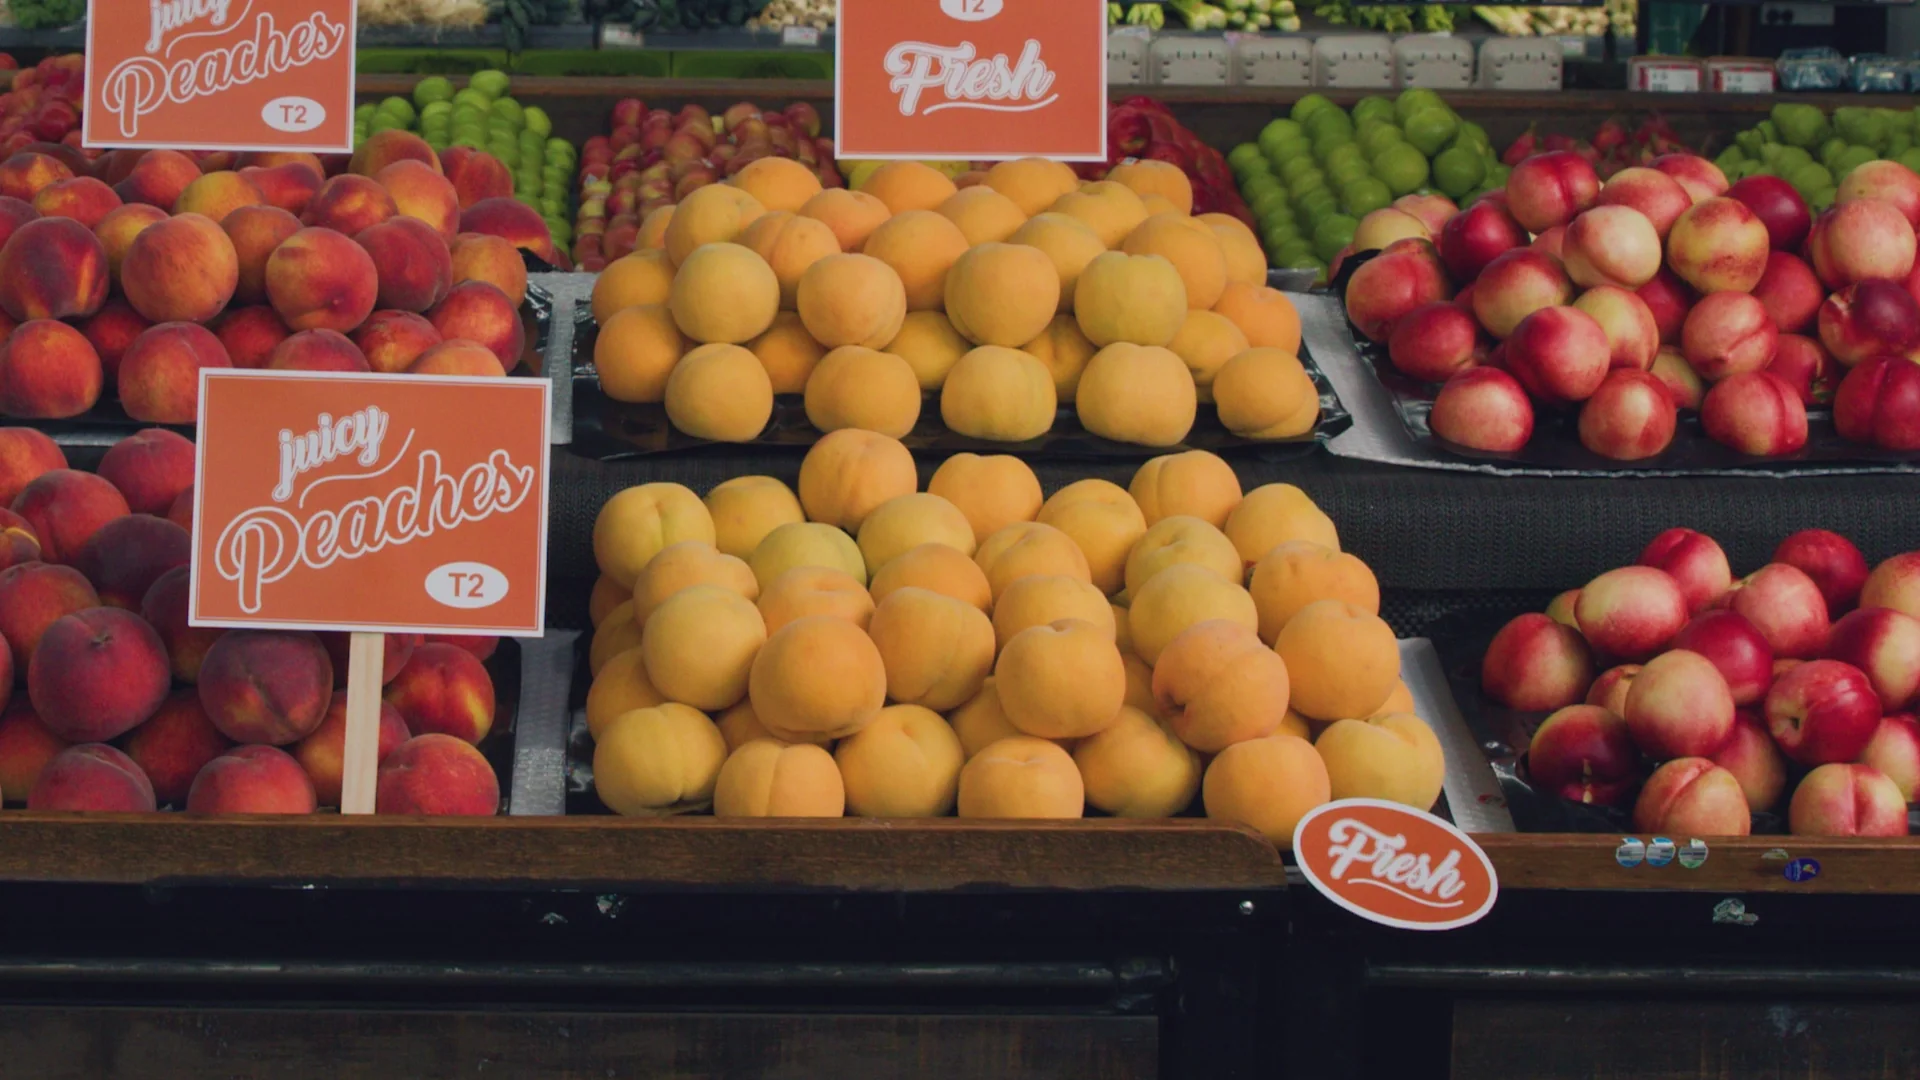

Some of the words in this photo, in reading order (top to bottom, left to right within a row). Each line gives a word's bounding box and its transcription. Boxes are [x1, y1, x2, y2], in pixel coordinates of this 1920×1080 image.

[144, 0, 232, 54] juicy
[102, 12, 345, 138] Peaches
[279, 105, 307, 124] T2
[883, 38, 1056, 116] Fresh
[272, 405, 389, 502] juicy
[215, 449, 534, 614] Peaches
[448, 573, 484, 598] T2
[1328, 818, 1466, 899] Fresh
